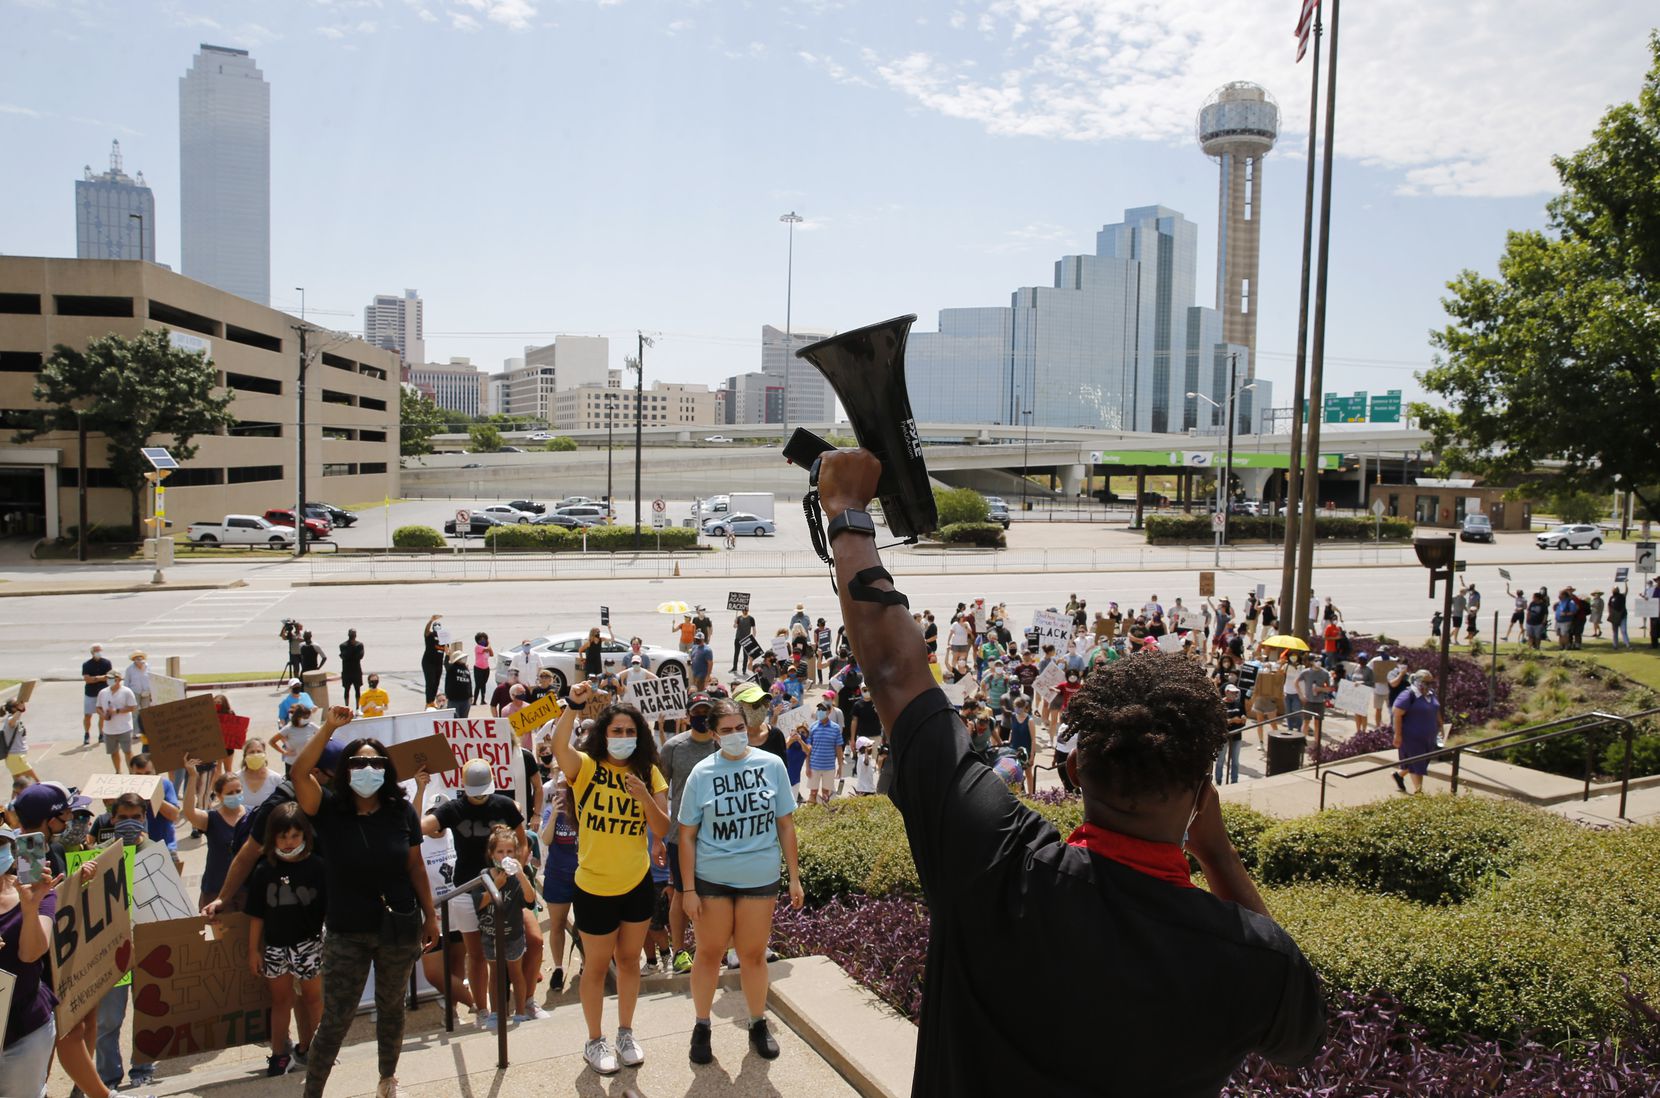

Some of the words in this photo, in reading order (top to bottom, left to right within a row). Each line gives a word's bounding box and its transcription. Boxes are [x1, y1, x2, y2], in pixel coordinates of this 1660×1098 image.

[906, 418, 921, 457] PYLE
[1034, 626, 1067, 640] BLACK
[633, 678, 681, 697] NEVER
[640, 690, 687, 714] AGAIN!
[521, 702, 557, 727] AGAIN!
[433, 720, 496, 739] MAKE
[452, 743, 511, 766] ACISM
[96, 776, 154, 787] NEVER
[713, 767, 767, 796] BLACK
[594, 793, 641, 817] LIVE
[715, 790, 771, 817] LIVES
[586, 812, 647, 836] MATTER
[713, 811, 775, 841] MATTER
[52, 857, 130, 970] BLM
[69, 969, 113, 1014] #NEVERAGAIN
